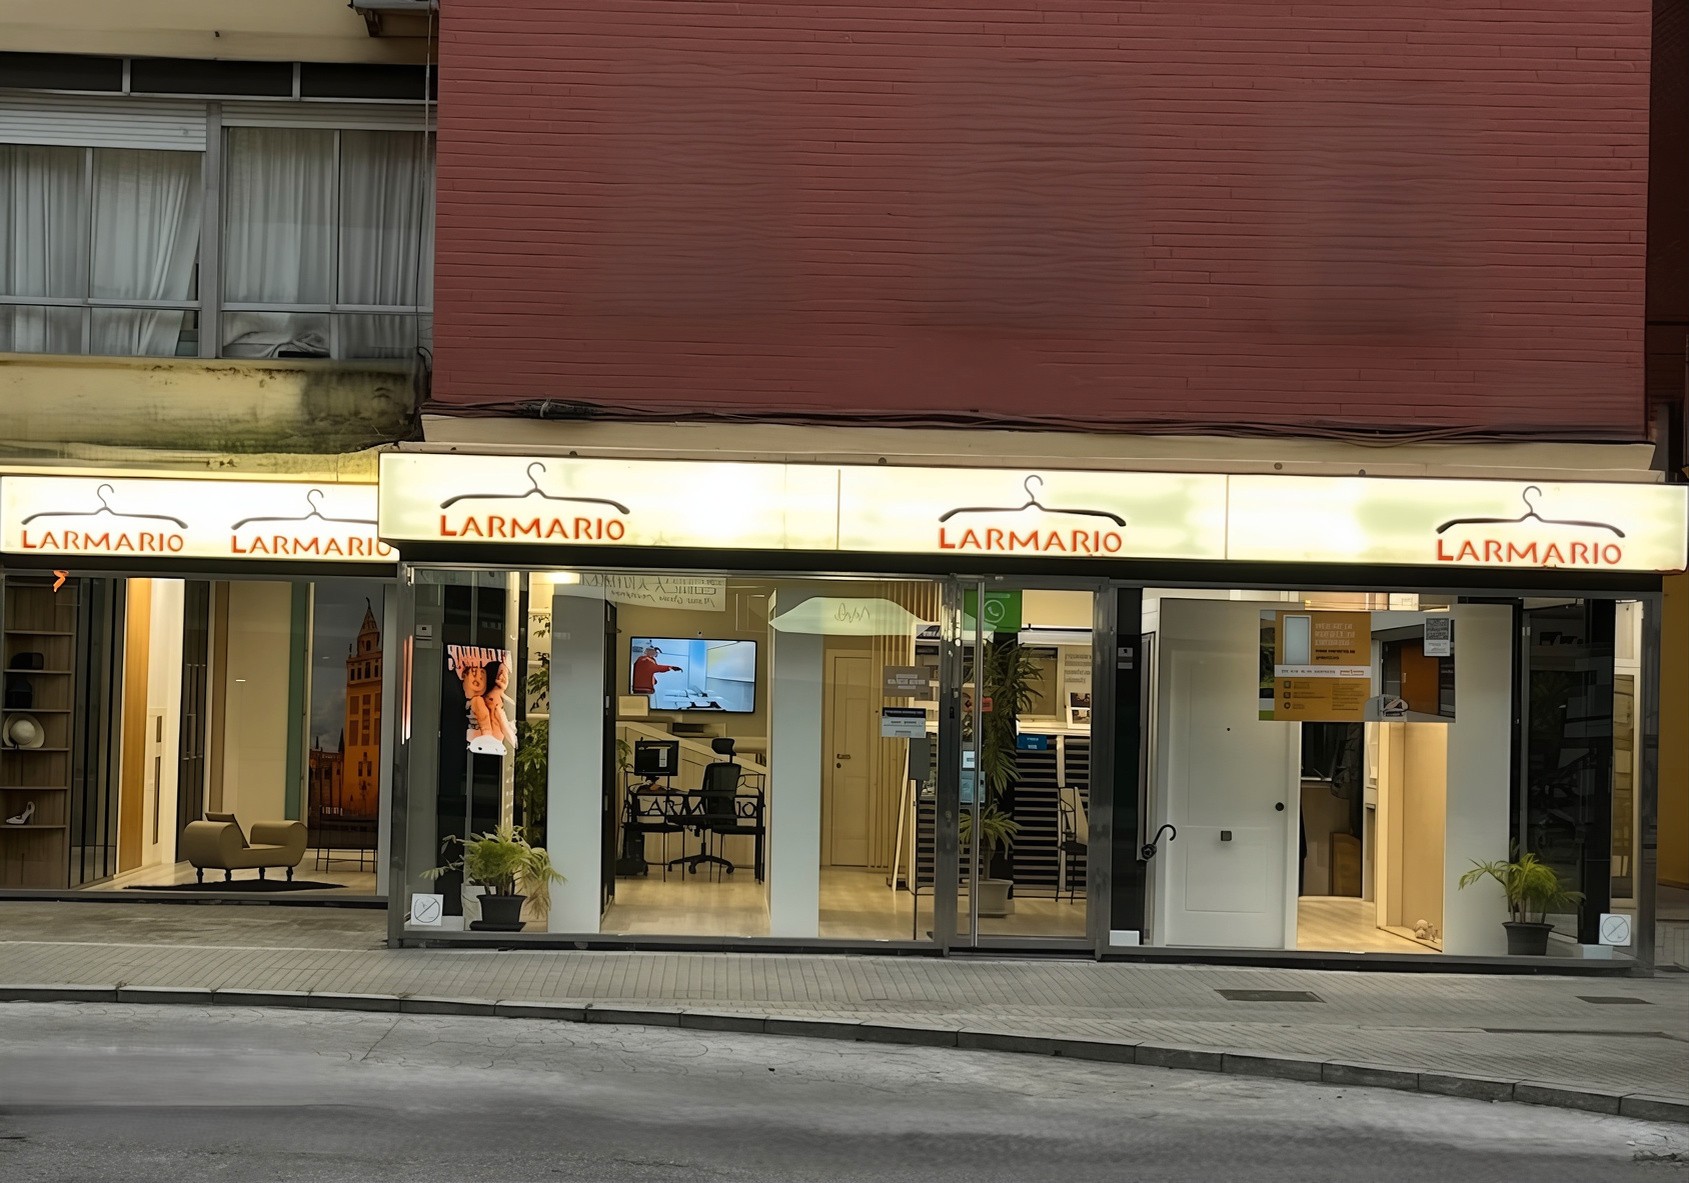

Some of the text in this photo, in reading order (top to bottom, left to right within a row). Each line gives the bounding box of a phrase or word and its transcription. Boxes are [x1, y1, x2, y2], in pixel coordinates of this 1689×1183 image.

[21, 529, 184, 552] LARMARIO
[440, 514, 625, 541] LARMARIO
[938, 527, 1123, 553] LARMARIO
[231, 534, 392, 557] LARMARIO
[1436, 538, 1622, 565] LARMARIO
